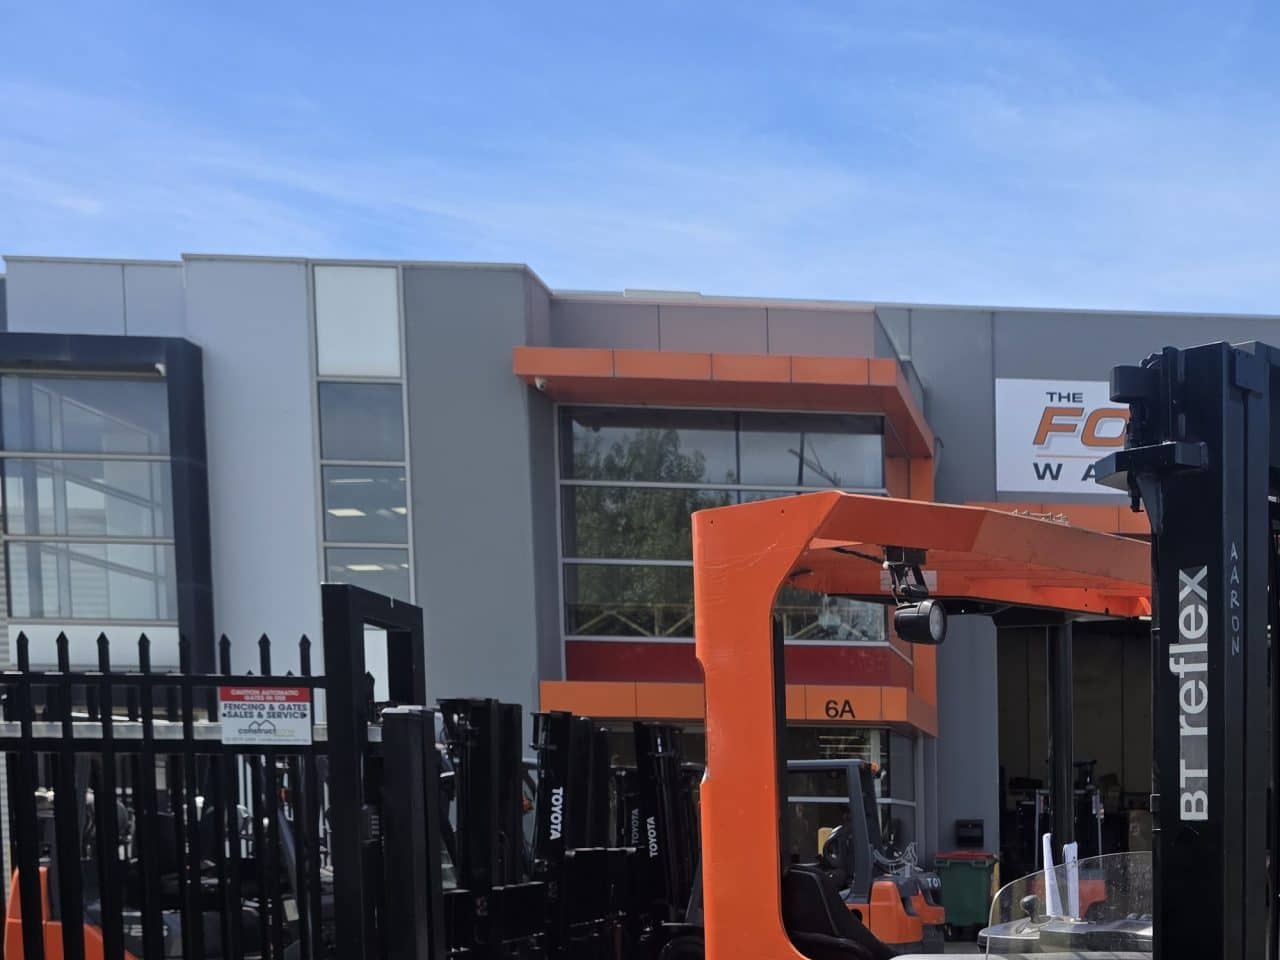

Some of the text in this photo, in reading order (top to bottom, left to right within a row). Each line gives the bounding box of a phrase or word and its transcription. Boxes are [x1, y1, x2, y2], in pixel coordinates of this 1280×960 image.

[1046, 392, 1083, 403] THE
[1230, 541, 1240, 657] AARON
[223, 703, 266, 711] FENCING
[269, 703, 275, 711] &
[1169, 565, 1208, 820] BT reflex
[227, 711, 254, 719] SALES
[825, 699, 856, 719] 6A
[549, 786, 564, 841] TOYOTA
[646, 816, 659, 858] TOYOTA
